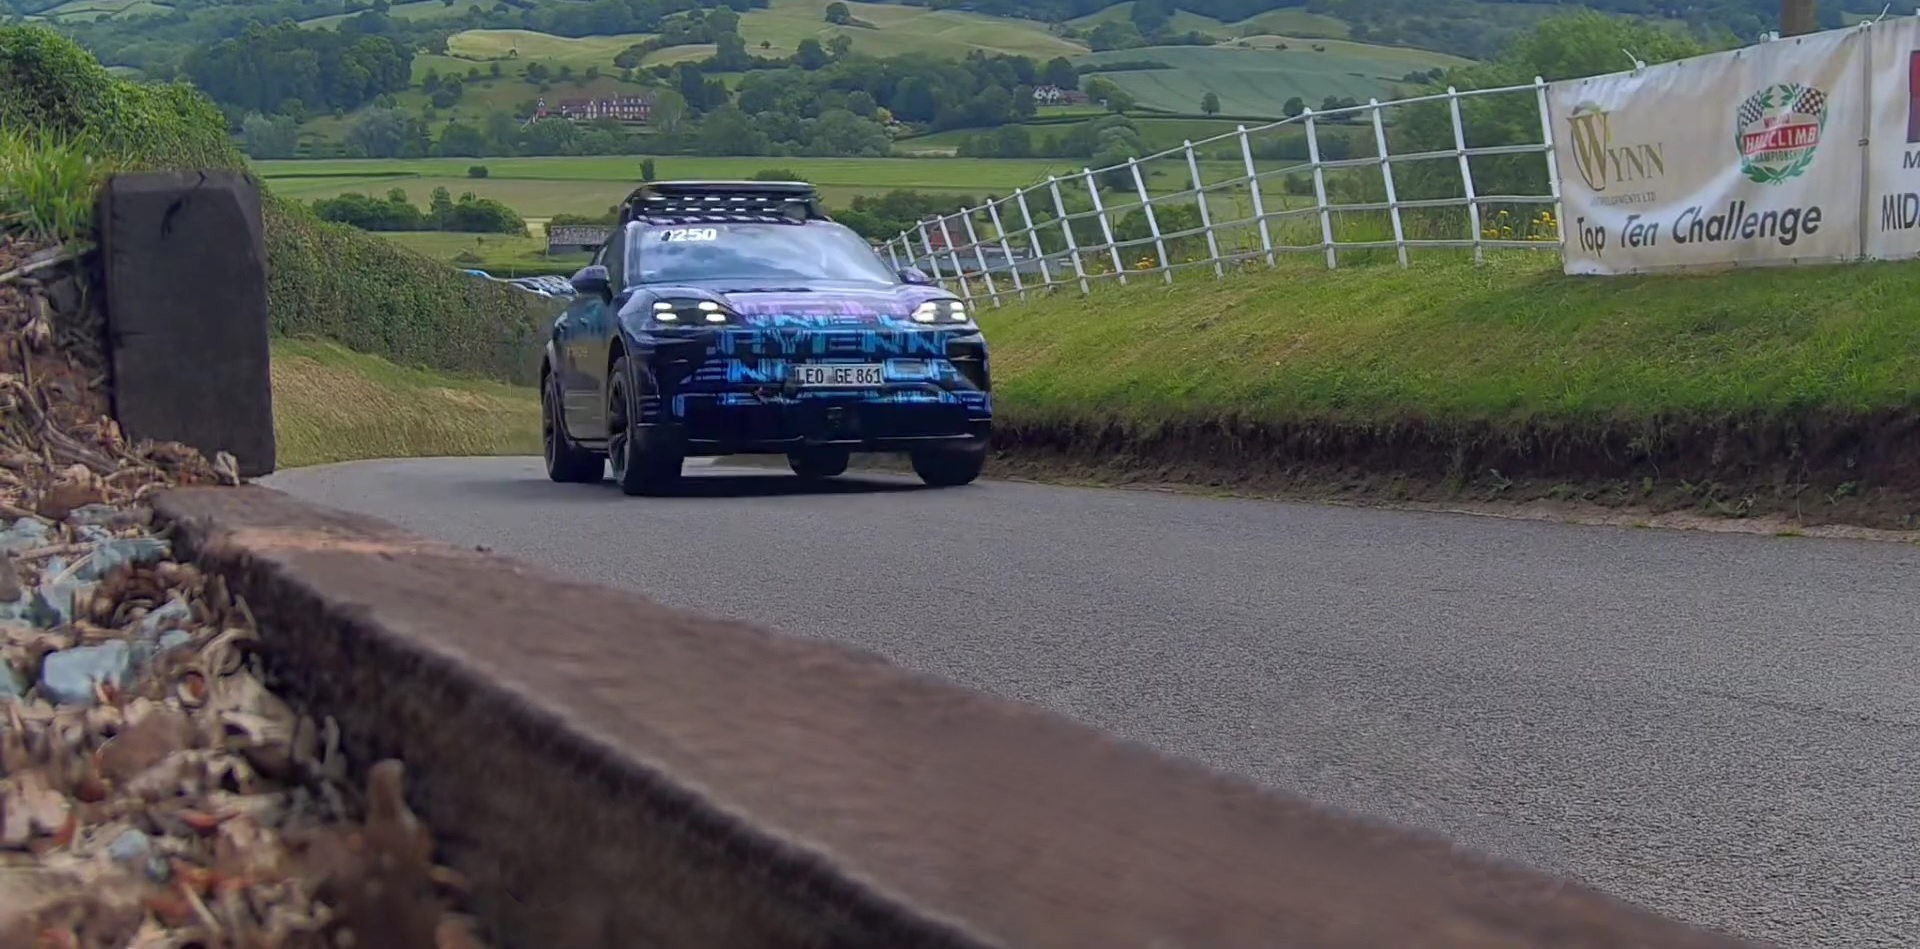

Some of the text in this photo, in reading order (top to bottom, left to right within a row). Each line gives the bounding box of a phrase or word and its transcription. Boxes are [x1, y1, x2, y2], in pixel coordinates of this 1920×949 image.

[1566, 110, 1665, 191] WYNN
[1577, 200, 1822, 258] Top Ten Challenge
[1881, 193, 1920, 233] MID
[835, 368, 854, 385] GE
[856, 368, 880, 385] 861
